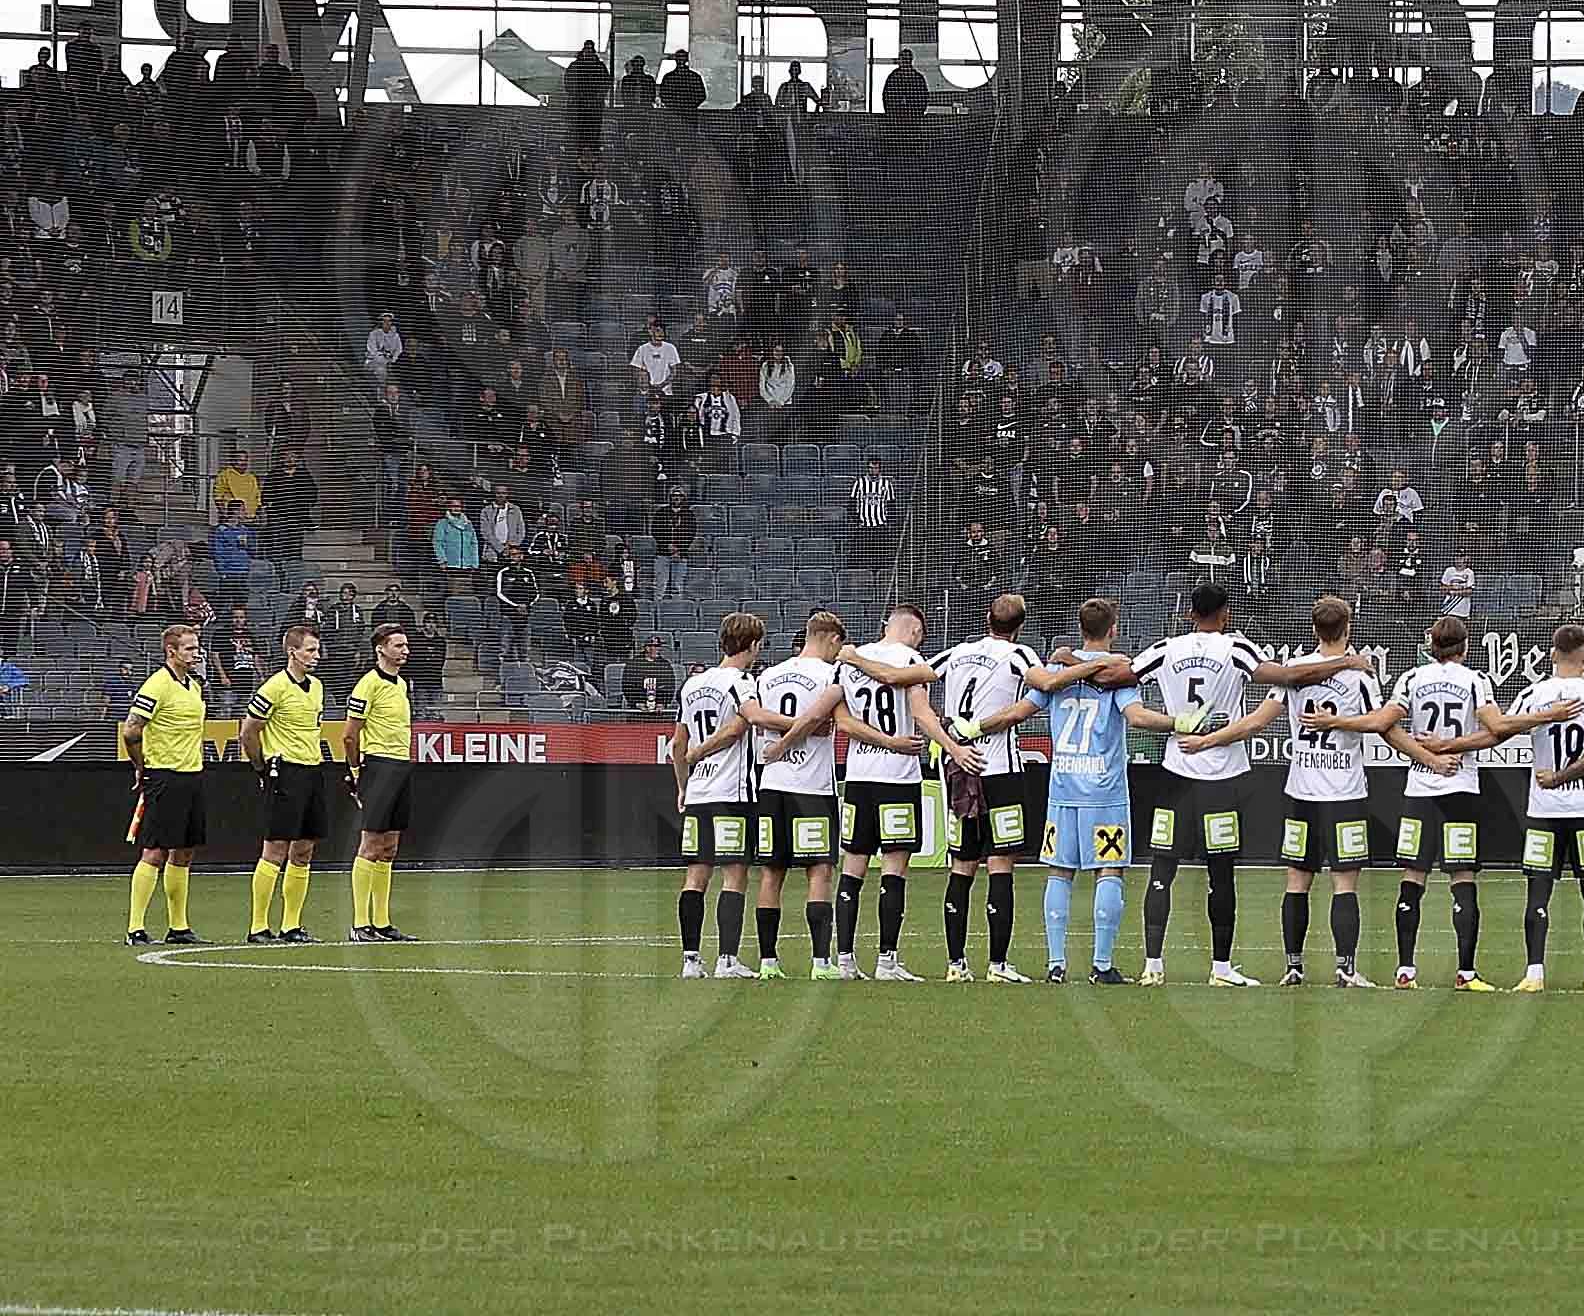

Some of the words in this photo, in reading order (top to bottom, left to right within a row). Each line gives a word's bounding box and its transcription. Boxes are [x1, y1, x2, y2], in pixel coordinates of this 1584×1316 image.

[154, 296, 180, 319] 14
[959, 678, 977, 719] 4
[1059, 697, 1101, 754] 27
[416, 734, 546, 763] KLEINE
[884, 807, 911, 835] E
[994, 810, 1021, 839] E
[1153, 811, 1170, 843] E
[1208, 818, 1235, 846] E
[714, 821, 743, 852] E
[798, 822, 824, 852] E
[1285, 823, 1301, 852] E
[1342, 826, 1364, 854] E
[1400, 822, 1417, 851] E
[1450, 827, 1474, 856] E
[1526, 834, 1547, 864] E
